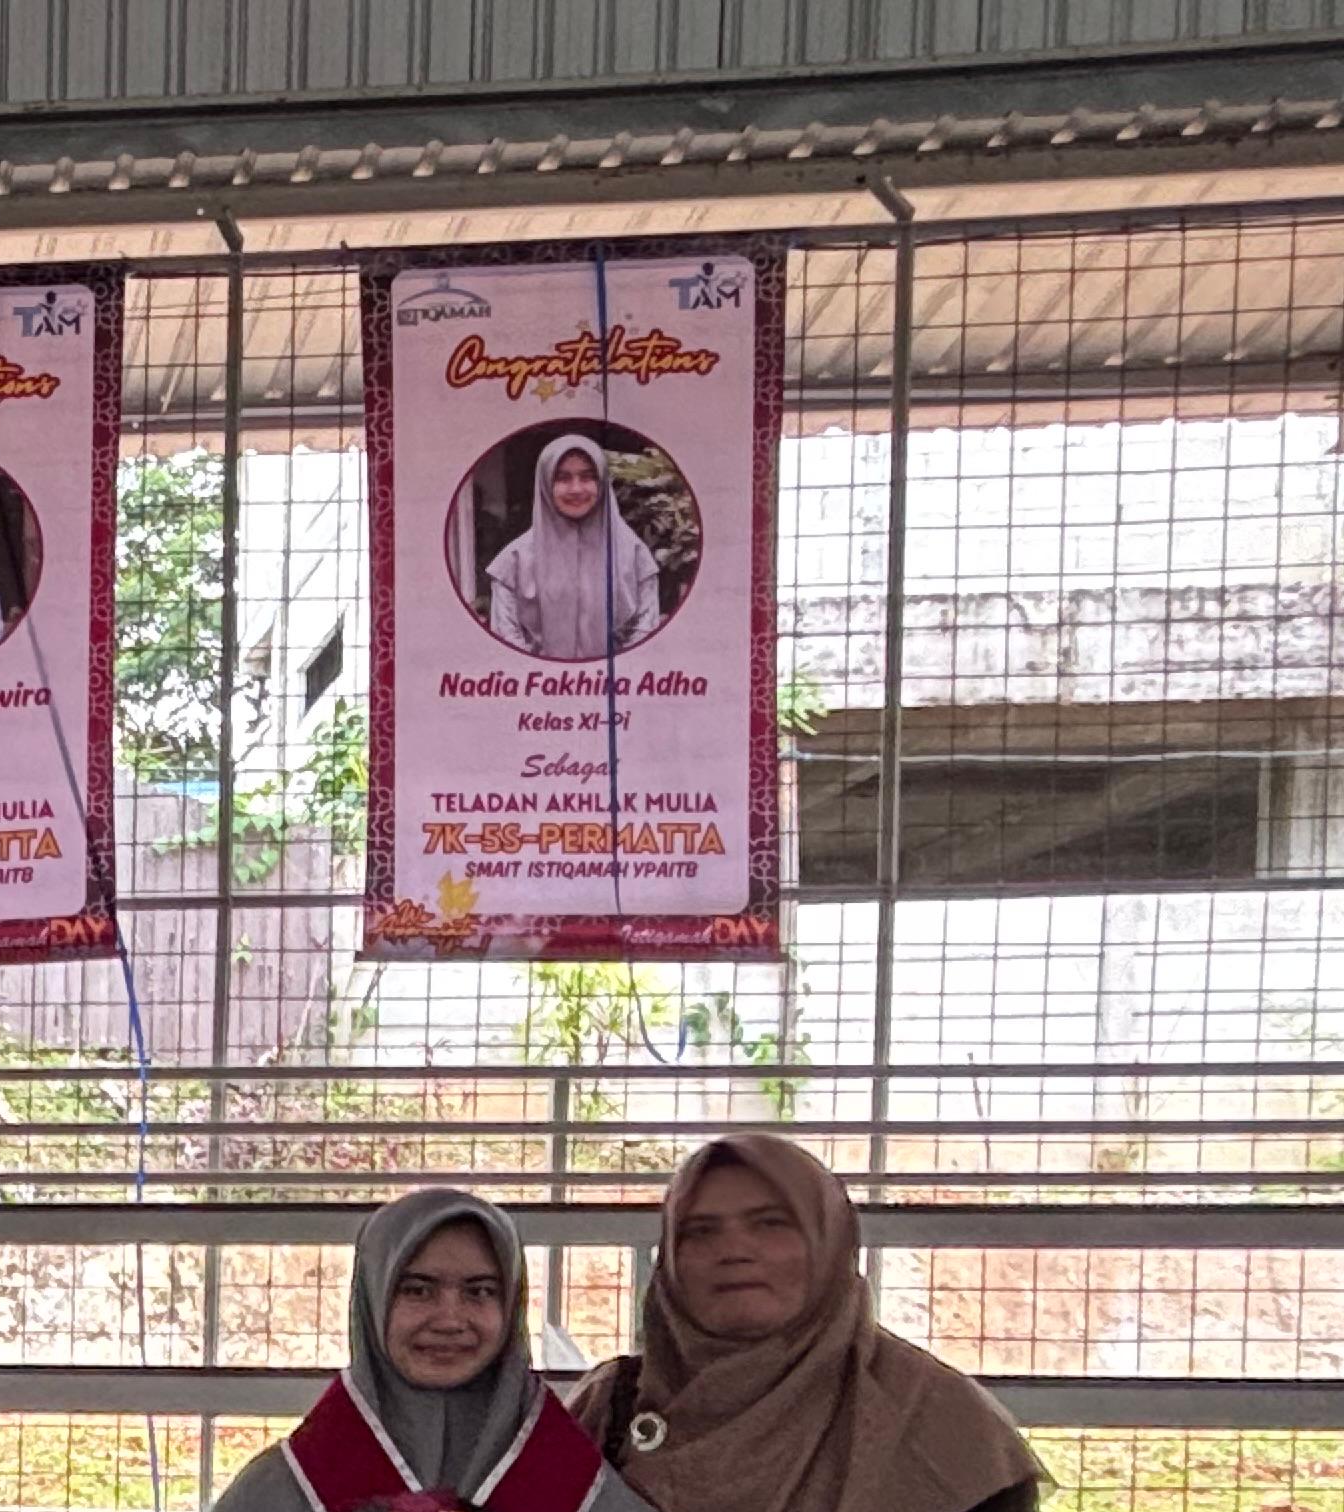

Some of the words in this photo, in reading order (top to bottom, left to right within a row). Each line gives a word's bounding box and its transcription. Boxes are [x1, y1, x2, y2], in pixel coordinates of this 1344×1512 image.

[446, 324, 720, 400] Congratulations
[439, 671, 519, 698] Nadia
[636, 670, 708, 697] Adha
[518, 711, 574, 732] Kelas
[431, 793, 538, 813] TELADAN
[645, 792, 719, 813] MULIA
[422, 822, 726, 856] 7K-5S-PERMATTA
[465, 861, 523, 879] SMAIT
[527, 861, 629, 880] ISTIQAMAH
[633, 861, 698, 879] YPAITB
